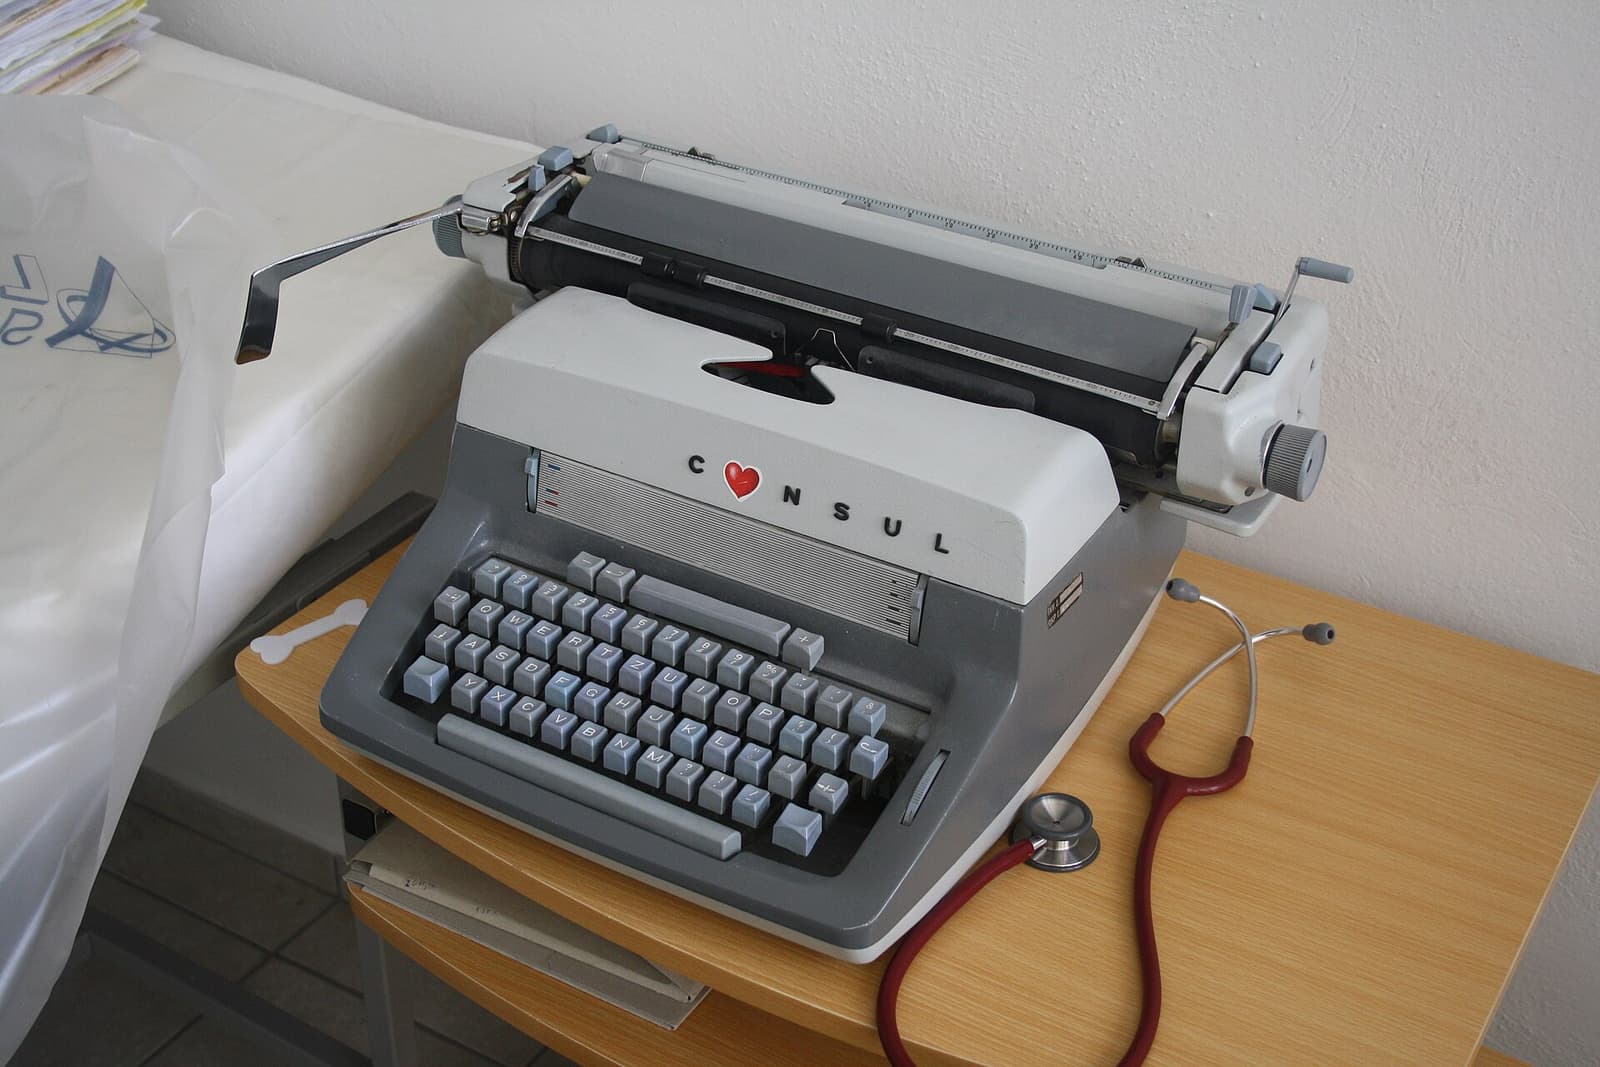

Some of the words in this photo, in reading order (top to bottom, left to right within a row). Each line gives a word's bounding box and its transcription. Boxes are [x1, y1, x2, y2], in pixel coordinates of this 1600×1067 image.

[688, 454, 950, 555] CNSUL
[465, 640, 477, 649] A
[495, 650, 508, 660] S
[524, 663, 538, 672] D
[555, 674, 570, 684] F
[586, 688, 598, 699] G
[615, 698, 630, 708] H
[648, 713, 663, 722] J
[681, 723, 696, 735] K
[714, 736, 725, 746] L
[509, 615, 526, 625] W
[536, 625, 550, 636] E
[568, 636, 583, 646] R
[600, 647, 614, 657] T
[630, 659, 645, 671] Z
[663, 672, 678, 683] U
[727, 697, 739, 705] O
[758, 708, 774, 717] P
[464, 677, 477, 688] Y
[491, 690, 506, 701] X
[521, 702, 534, 712] C
[555, 714, 568, 724] V
[582, 726, 596, 737] B
[614, 738, 629, 750] N
[646, 751, 664, 762] M
